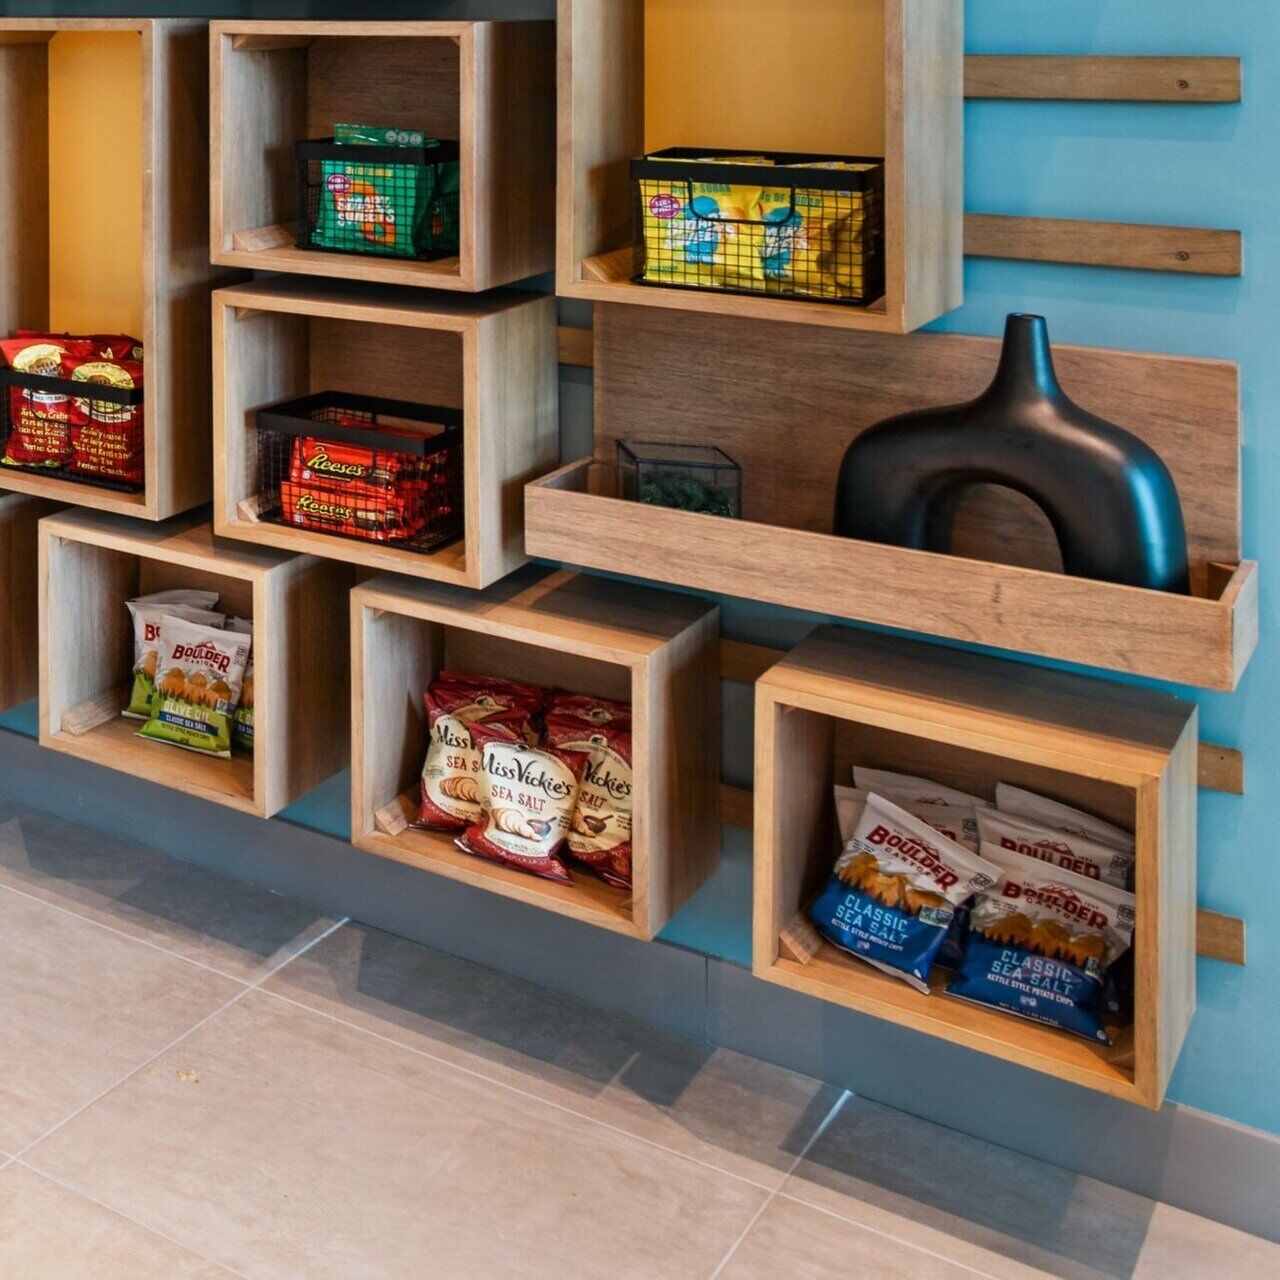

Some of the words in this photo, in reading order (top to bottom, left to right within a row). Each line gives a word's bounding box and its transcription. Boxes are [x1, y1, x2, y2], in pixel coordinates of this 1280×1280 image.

[172, 644, 231, 673] BOULDER
[164, 700, 192, 717] OLIVE
[195, 710, 211, 724] OIL
[165, 714, 184, 725] CLASSIC
[185, 719, 194, 728] SEA
[195, 721, 207, 731] SALT
[437, 724, 468, 748] Miss
[447, 756, 467, 771] SEA
[479, 752, 515, 780] Miss
[514, 758, 573, 799] Vickie's
[584, 761, 631, 799] Vickie's
[492, 785, 513, 802] SEA
[518, 791, 546, 811] SALT
[580, 791, 607, 808] SALT
[866, 825, 959, 891] BOULDER
[845, 894, 908, 932] CLASSIC
[1002, 880, 1109, 930] BOULDER
[835, 905, 863, 926] SEA
[869, 922, 909, 944] SALT
[991, 960, 1023, 980] SEA
[1030, 973, 1075, 996] SALT
[1001, 950, 1072, 983] CLASSIC
[987, 973, 1010, 986] KETTLE
[1011, 979, 1031, 993] STYLE
[1031, 986, 1055, 1001] POTATO
[1055, 993, 1075, 1008] CHIPS
